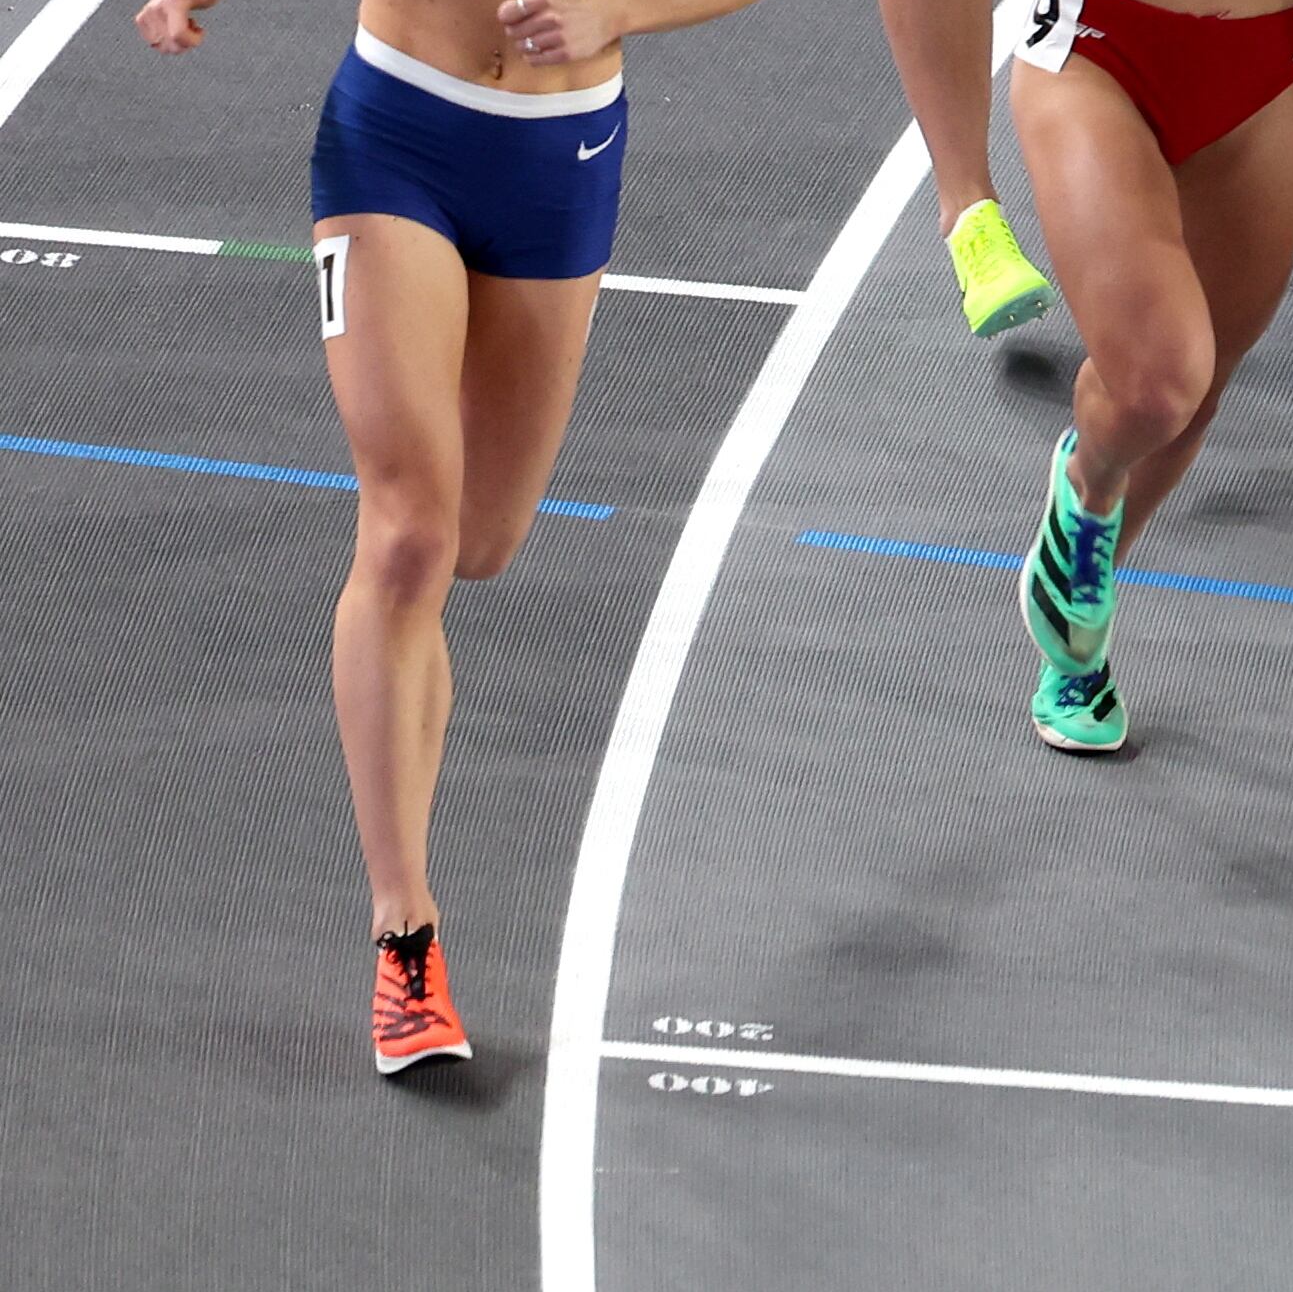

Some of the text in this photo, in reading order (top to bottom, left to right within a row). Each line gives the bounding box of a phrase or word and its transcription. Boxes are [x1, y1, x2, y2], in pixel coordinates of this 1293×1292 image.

[322, 254, 334, 322] 1
[652, 1016, 774, 1041] 200
[648, 1072, 774, 1097] 400
